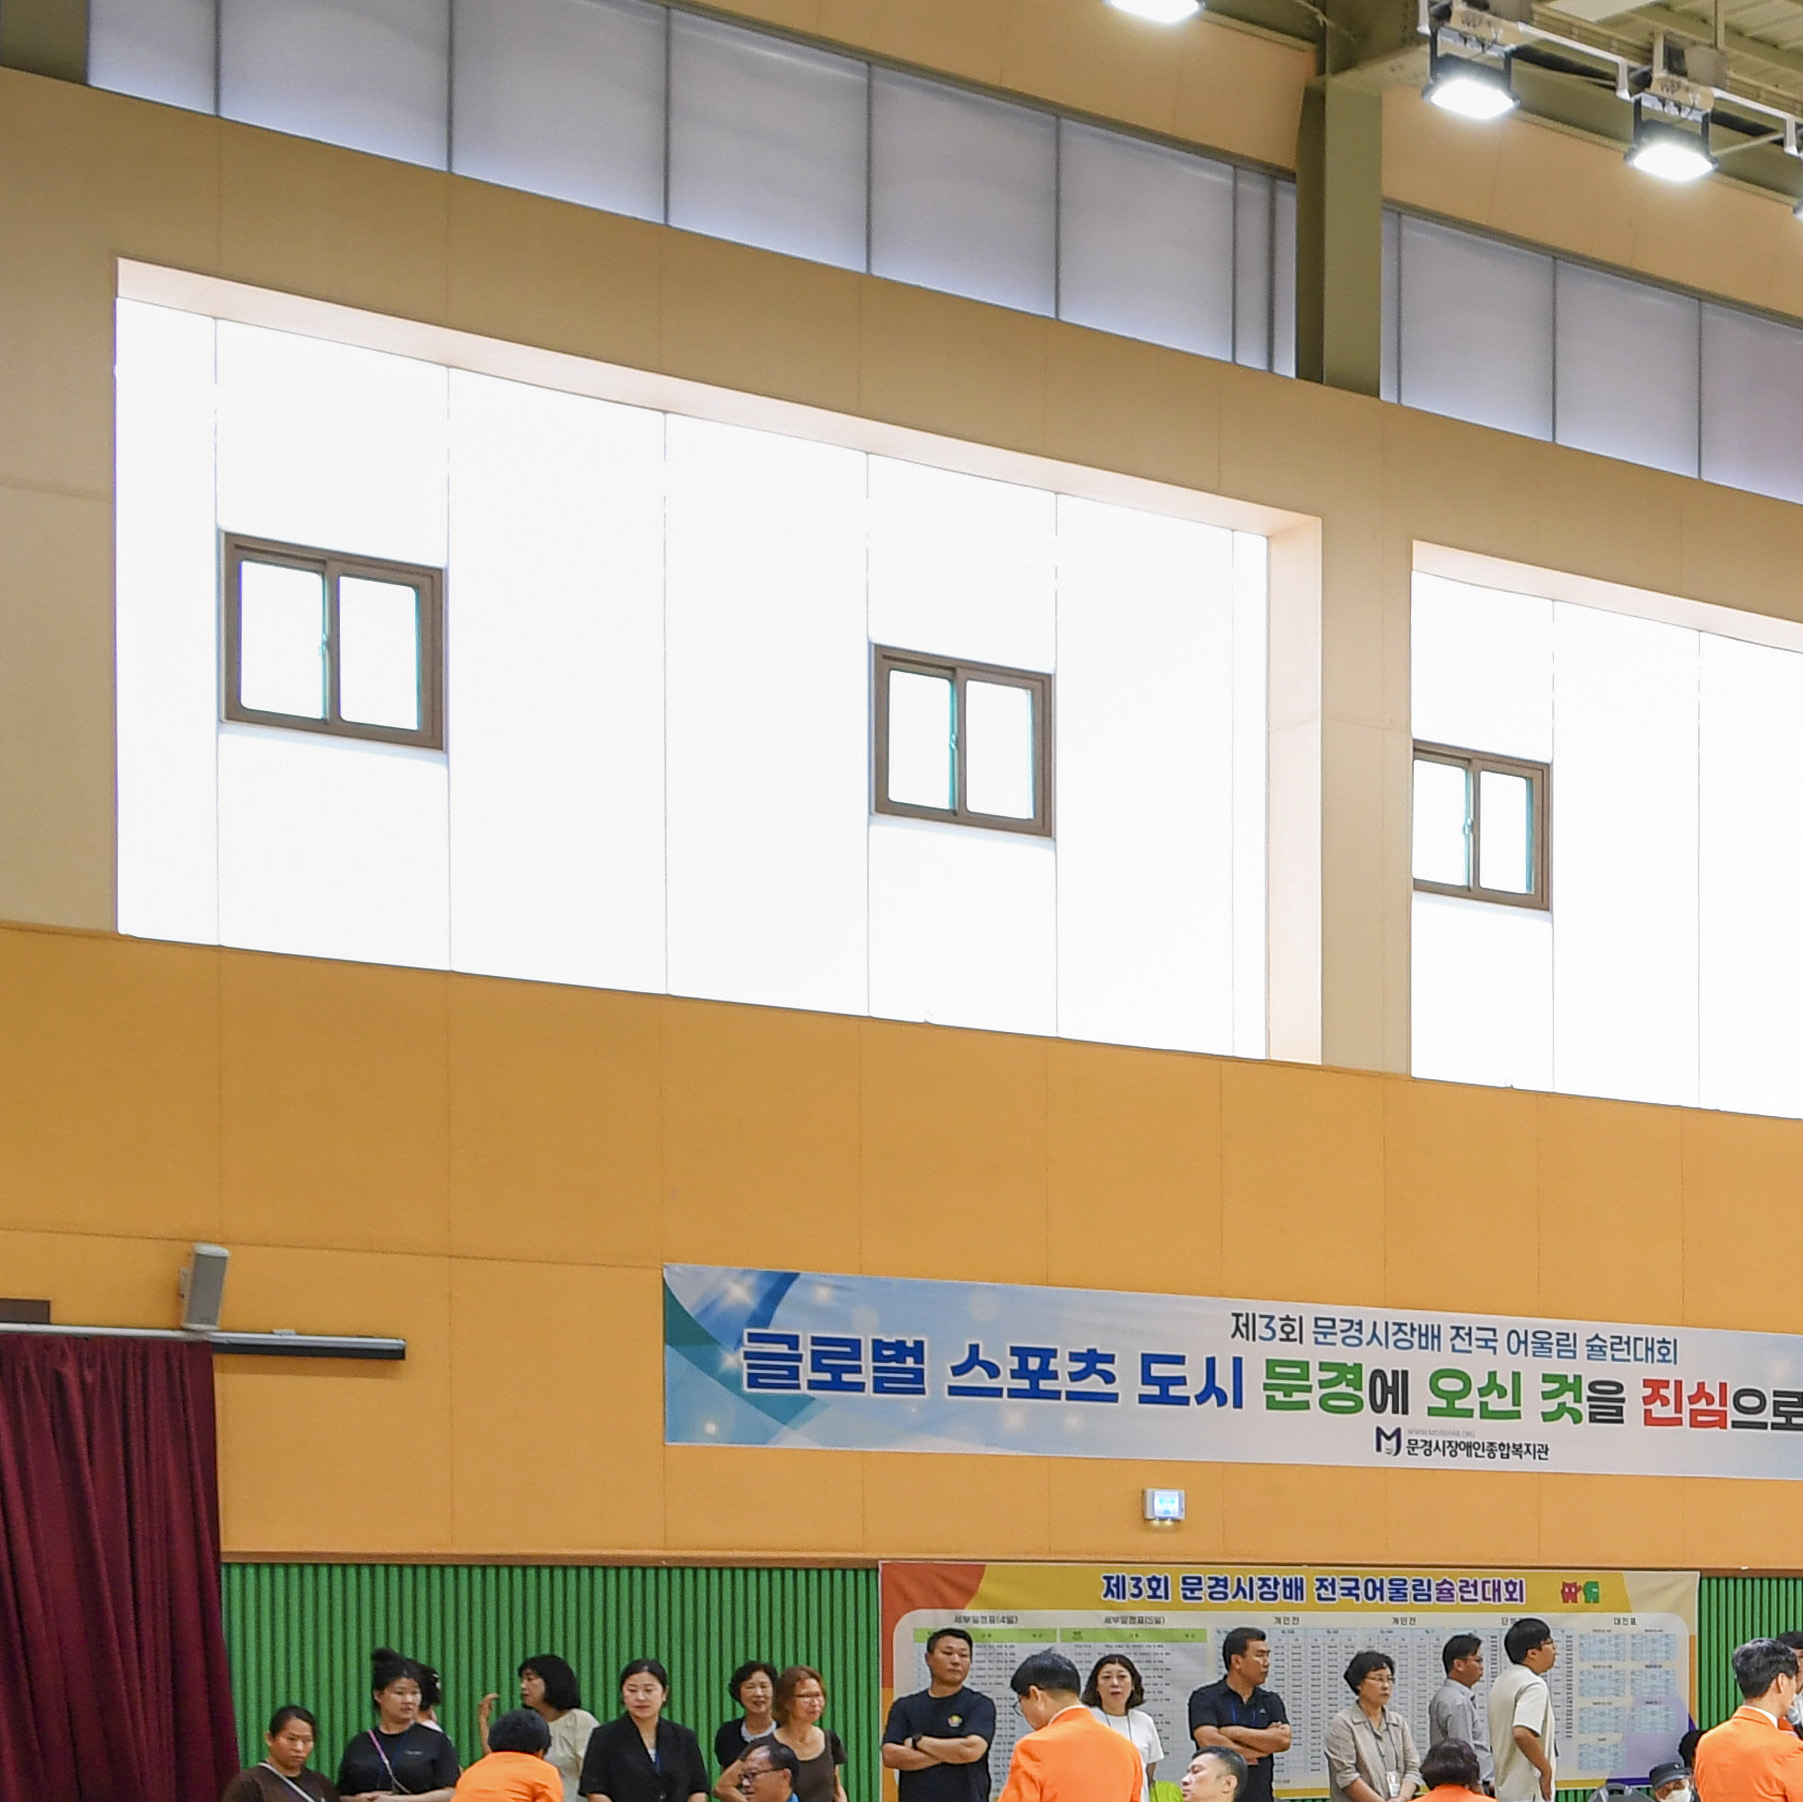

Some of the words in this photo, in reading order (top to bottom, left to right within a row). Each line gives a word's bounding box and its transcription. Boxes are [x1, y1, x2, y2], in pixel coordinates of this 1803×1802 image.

[1230, 1311, 1304, 1345] 제3회
[1312, 1316, 1442, 1352] 문경시장배
[1449, 1323, 1499, 1356] 전국
[1506, 1327, 1578, 1361] 어울림
[1585, 1332, 1678, 1366] 슐런대회
[742, 1331, 927, 1396] 글로벌
[946, 1341, 1120, 1404] 스포츠
[1137, 1352, 1243, 1410] 도시
[1262, 1357, 1410, 1416] 문경에
[1426, 1366, 1523, 1422] 오신
[1540, 1371, 1627, 1426] 것을
[1406, 1438, 1550, 1461] 문경시장애인종합복지관
[1102, 1574, 1170, 1601] 제3회
[1181, 1575, 1305, 1603] 문경시장배
[1315, 1576, 1526, 1604] 전국어울림슐런대회
